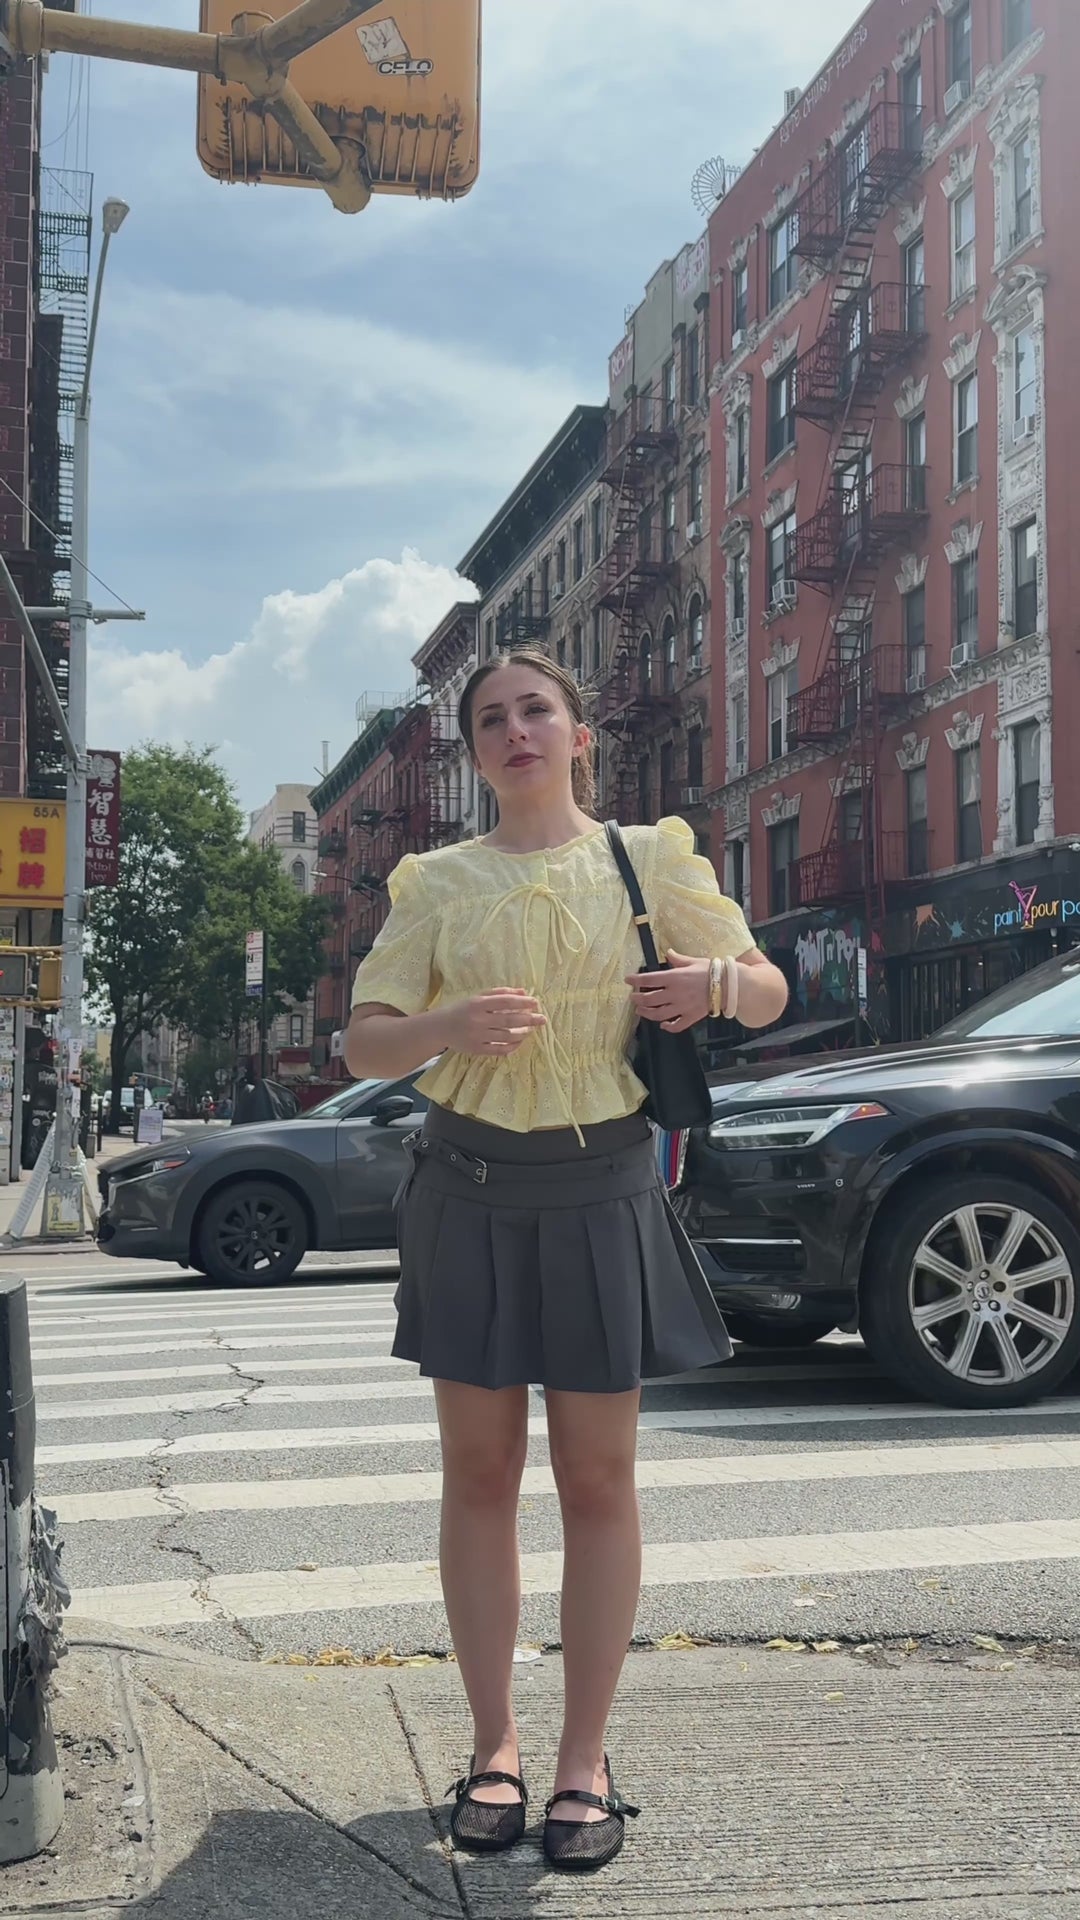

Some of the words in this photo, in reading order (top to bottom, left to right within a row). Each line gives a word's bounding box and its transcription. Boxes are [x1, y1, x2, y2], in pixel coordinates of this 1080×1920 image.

[87, 788, 115, 845] 智慧
[91, 872, 107, 882] Ivy
[994, 902, 1022, 935] paint
[1031, 900, 1060, 925] pour
